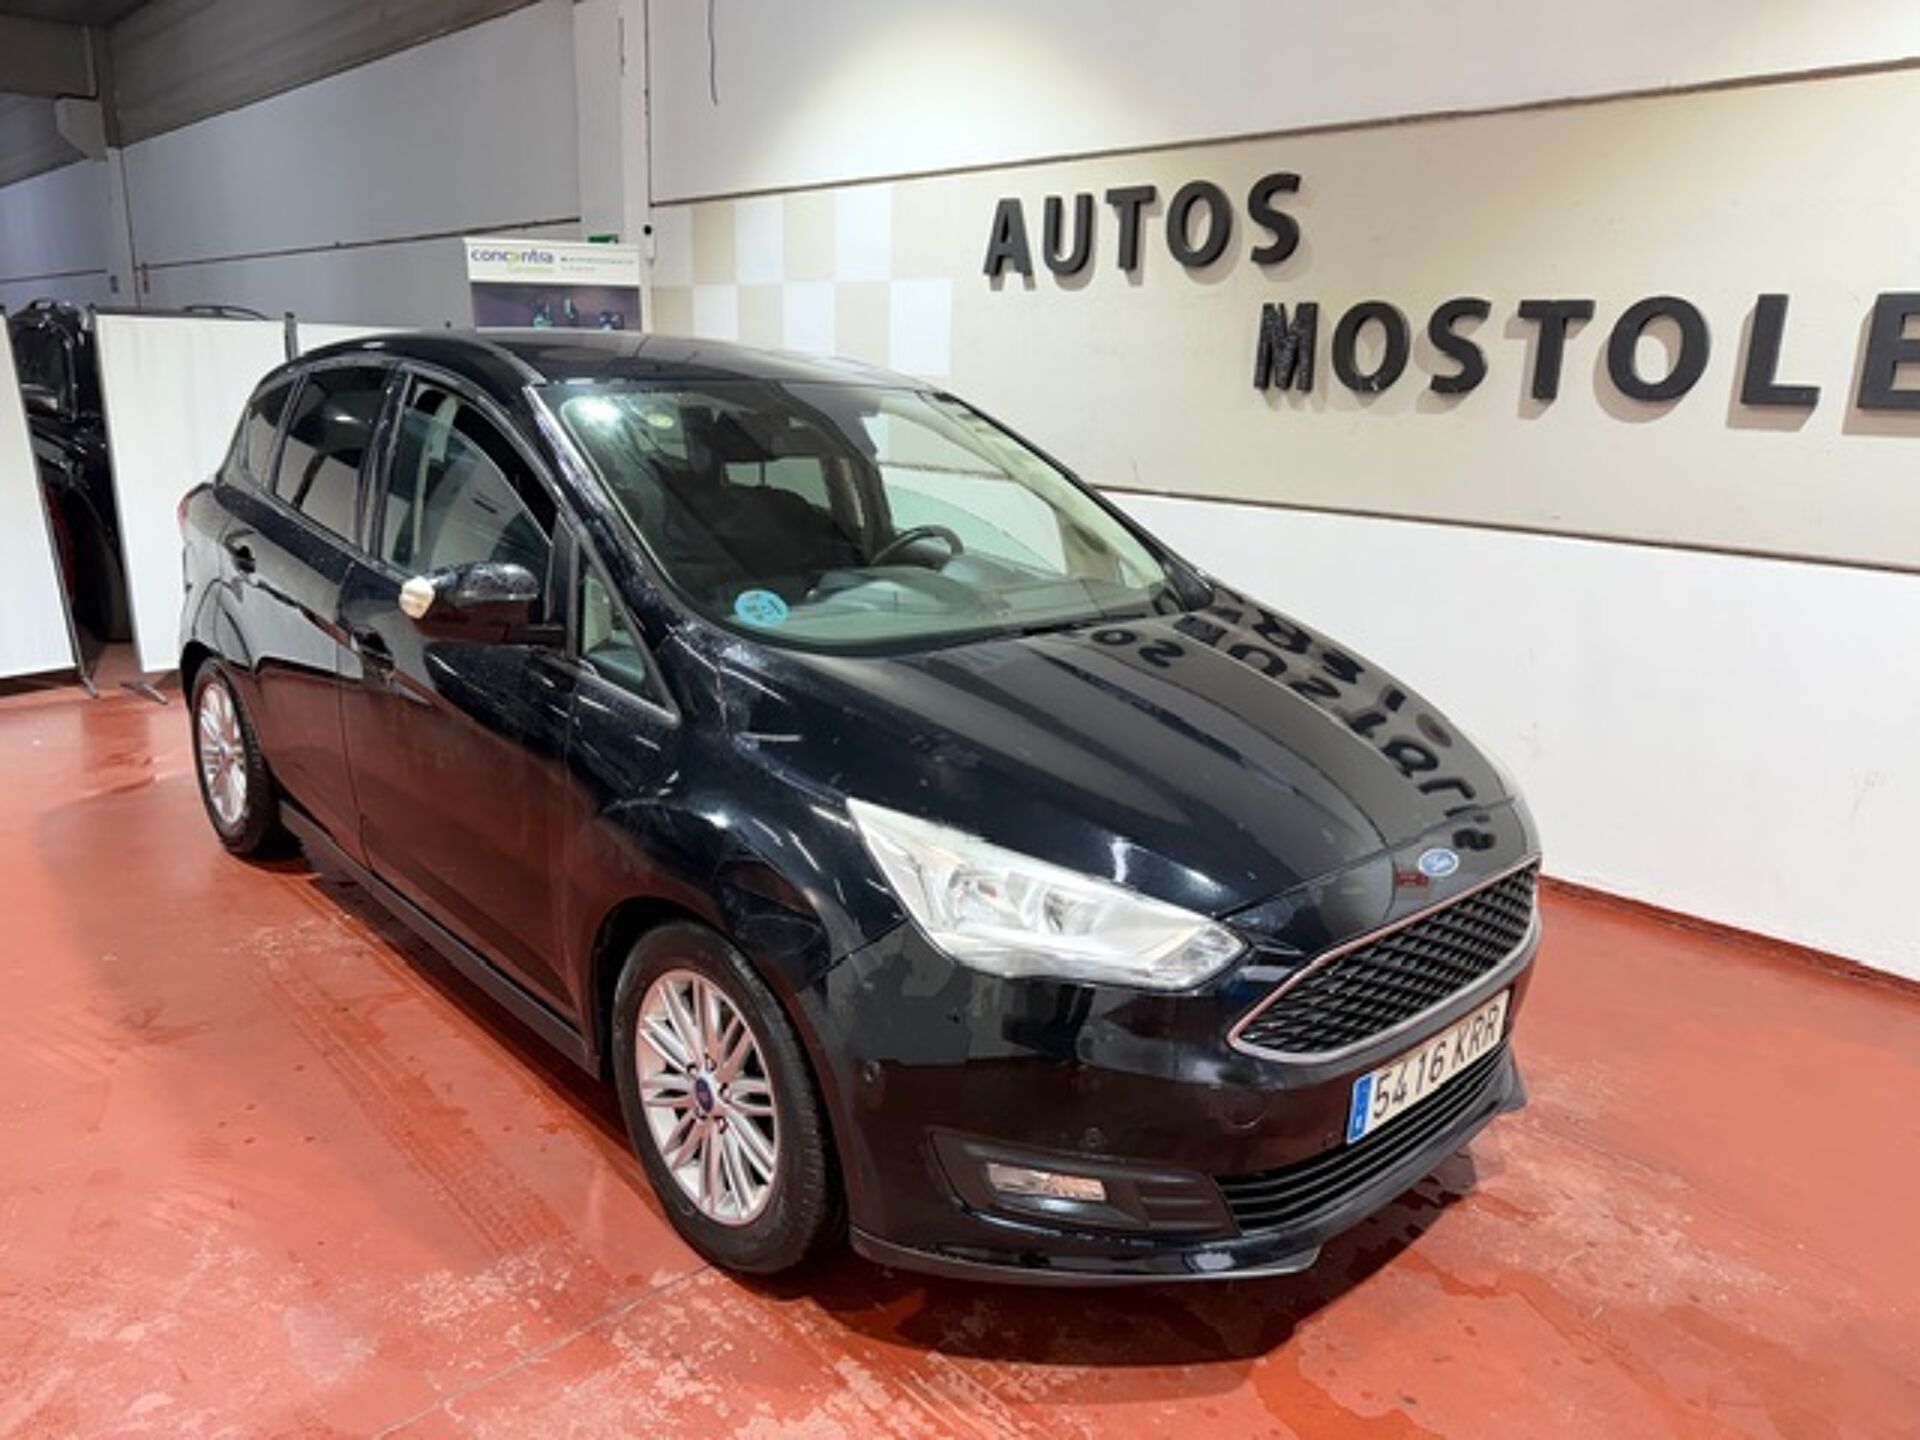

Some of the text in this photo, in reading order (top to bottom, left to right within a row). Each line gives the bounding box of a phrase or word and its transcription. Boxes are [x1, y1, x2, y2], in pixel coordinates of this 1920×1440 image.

[983, 172, 1302, 277] AUTOS
[1254, 292, 1920, 409] MOSTOLE
[1372, 1003, 1501, 1119] 5416 KRR
